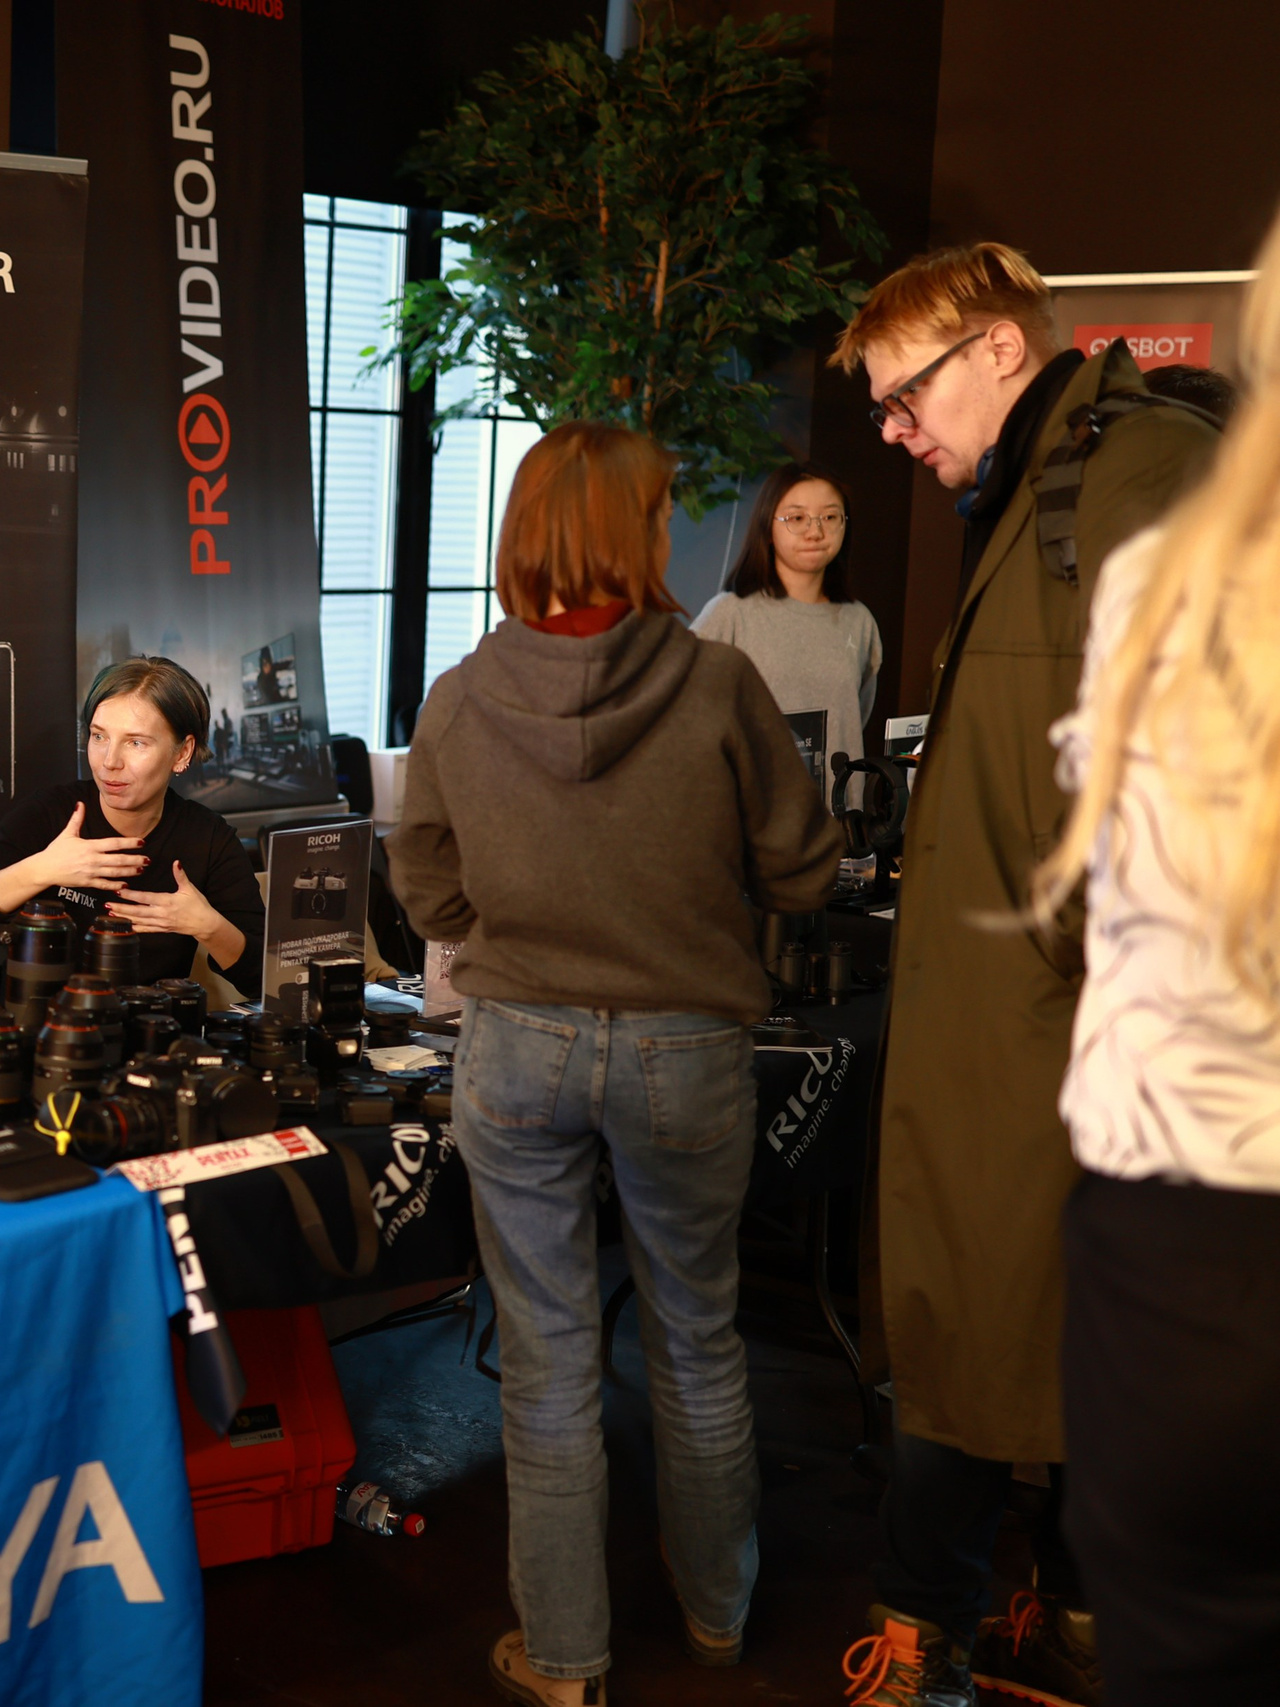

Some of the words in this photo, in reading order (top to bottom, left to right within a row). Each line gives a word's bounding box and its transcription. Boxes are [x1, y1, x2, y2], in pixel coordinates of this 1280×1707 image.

[1090, 336, 1194, 358] OSBOT
[307, 833, 341, 847] RICOH
[57, 886, 96, 909] PENTAX
[784, 1098, 833, 1169] imagine.
